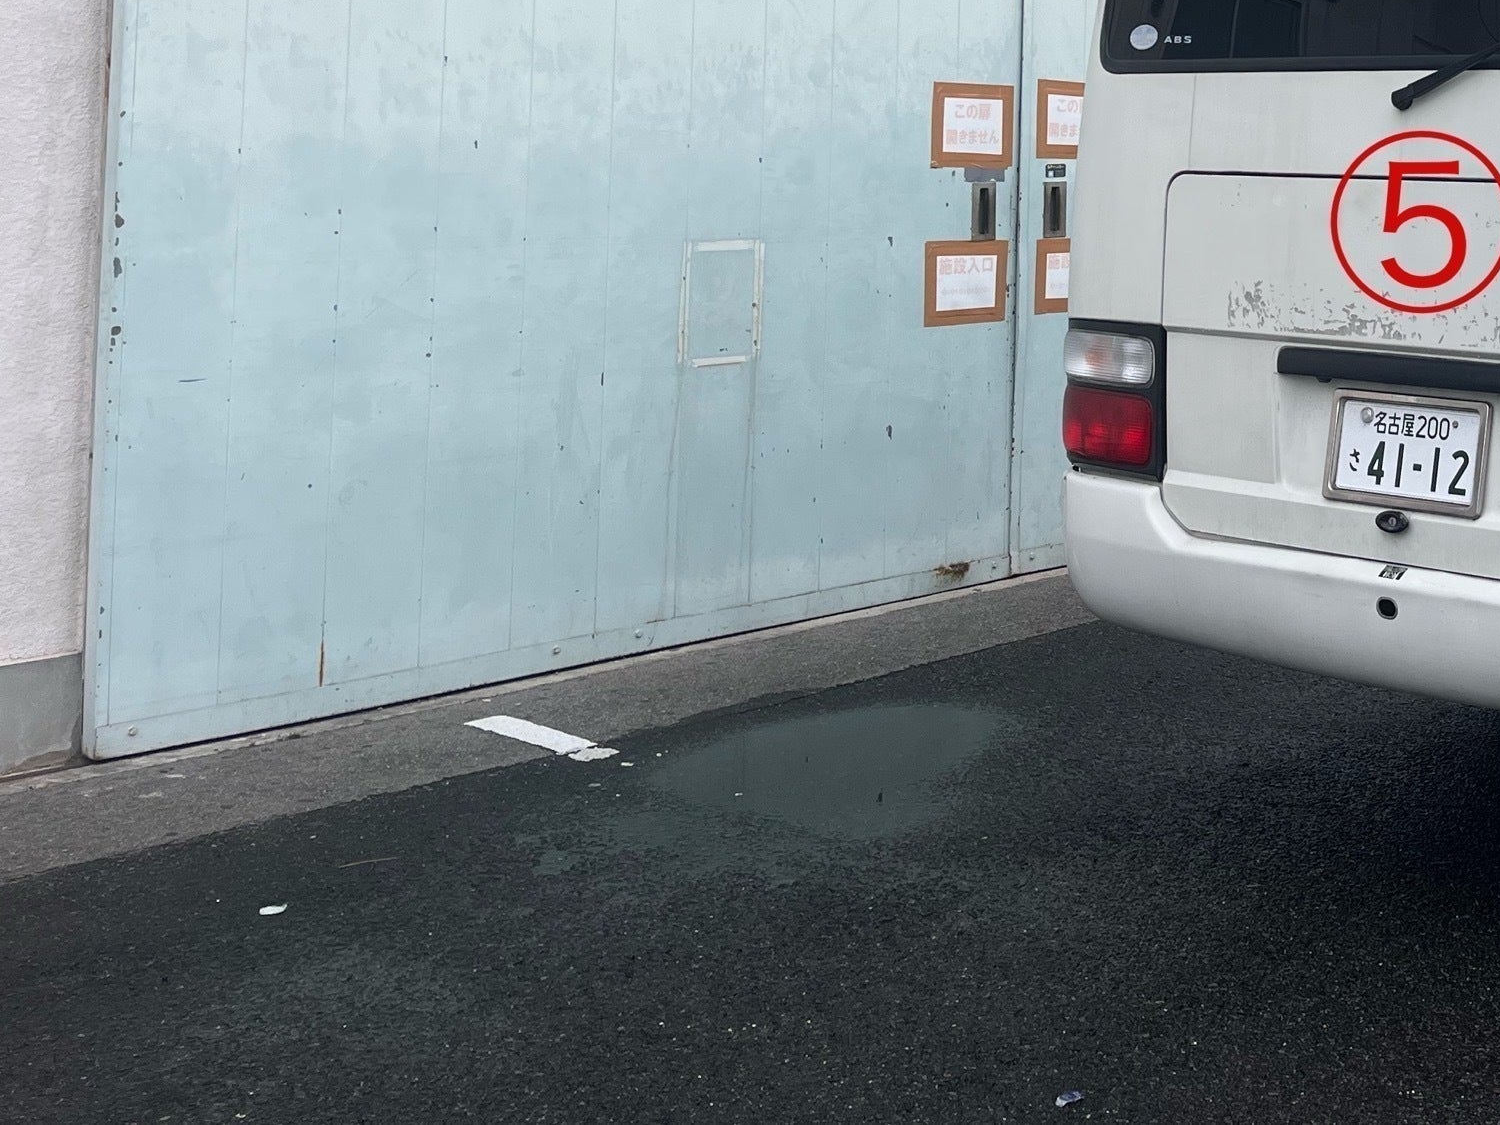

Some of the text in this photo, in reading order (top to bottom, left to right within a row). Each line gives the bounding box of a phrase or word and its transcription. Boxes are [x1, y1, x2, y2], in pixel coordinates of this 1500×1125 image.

[1164, 35, 1192, 44] ABS
[1056, 98, 1083, 114] この
[1349, 440, 1470, 497] さ 41-12
